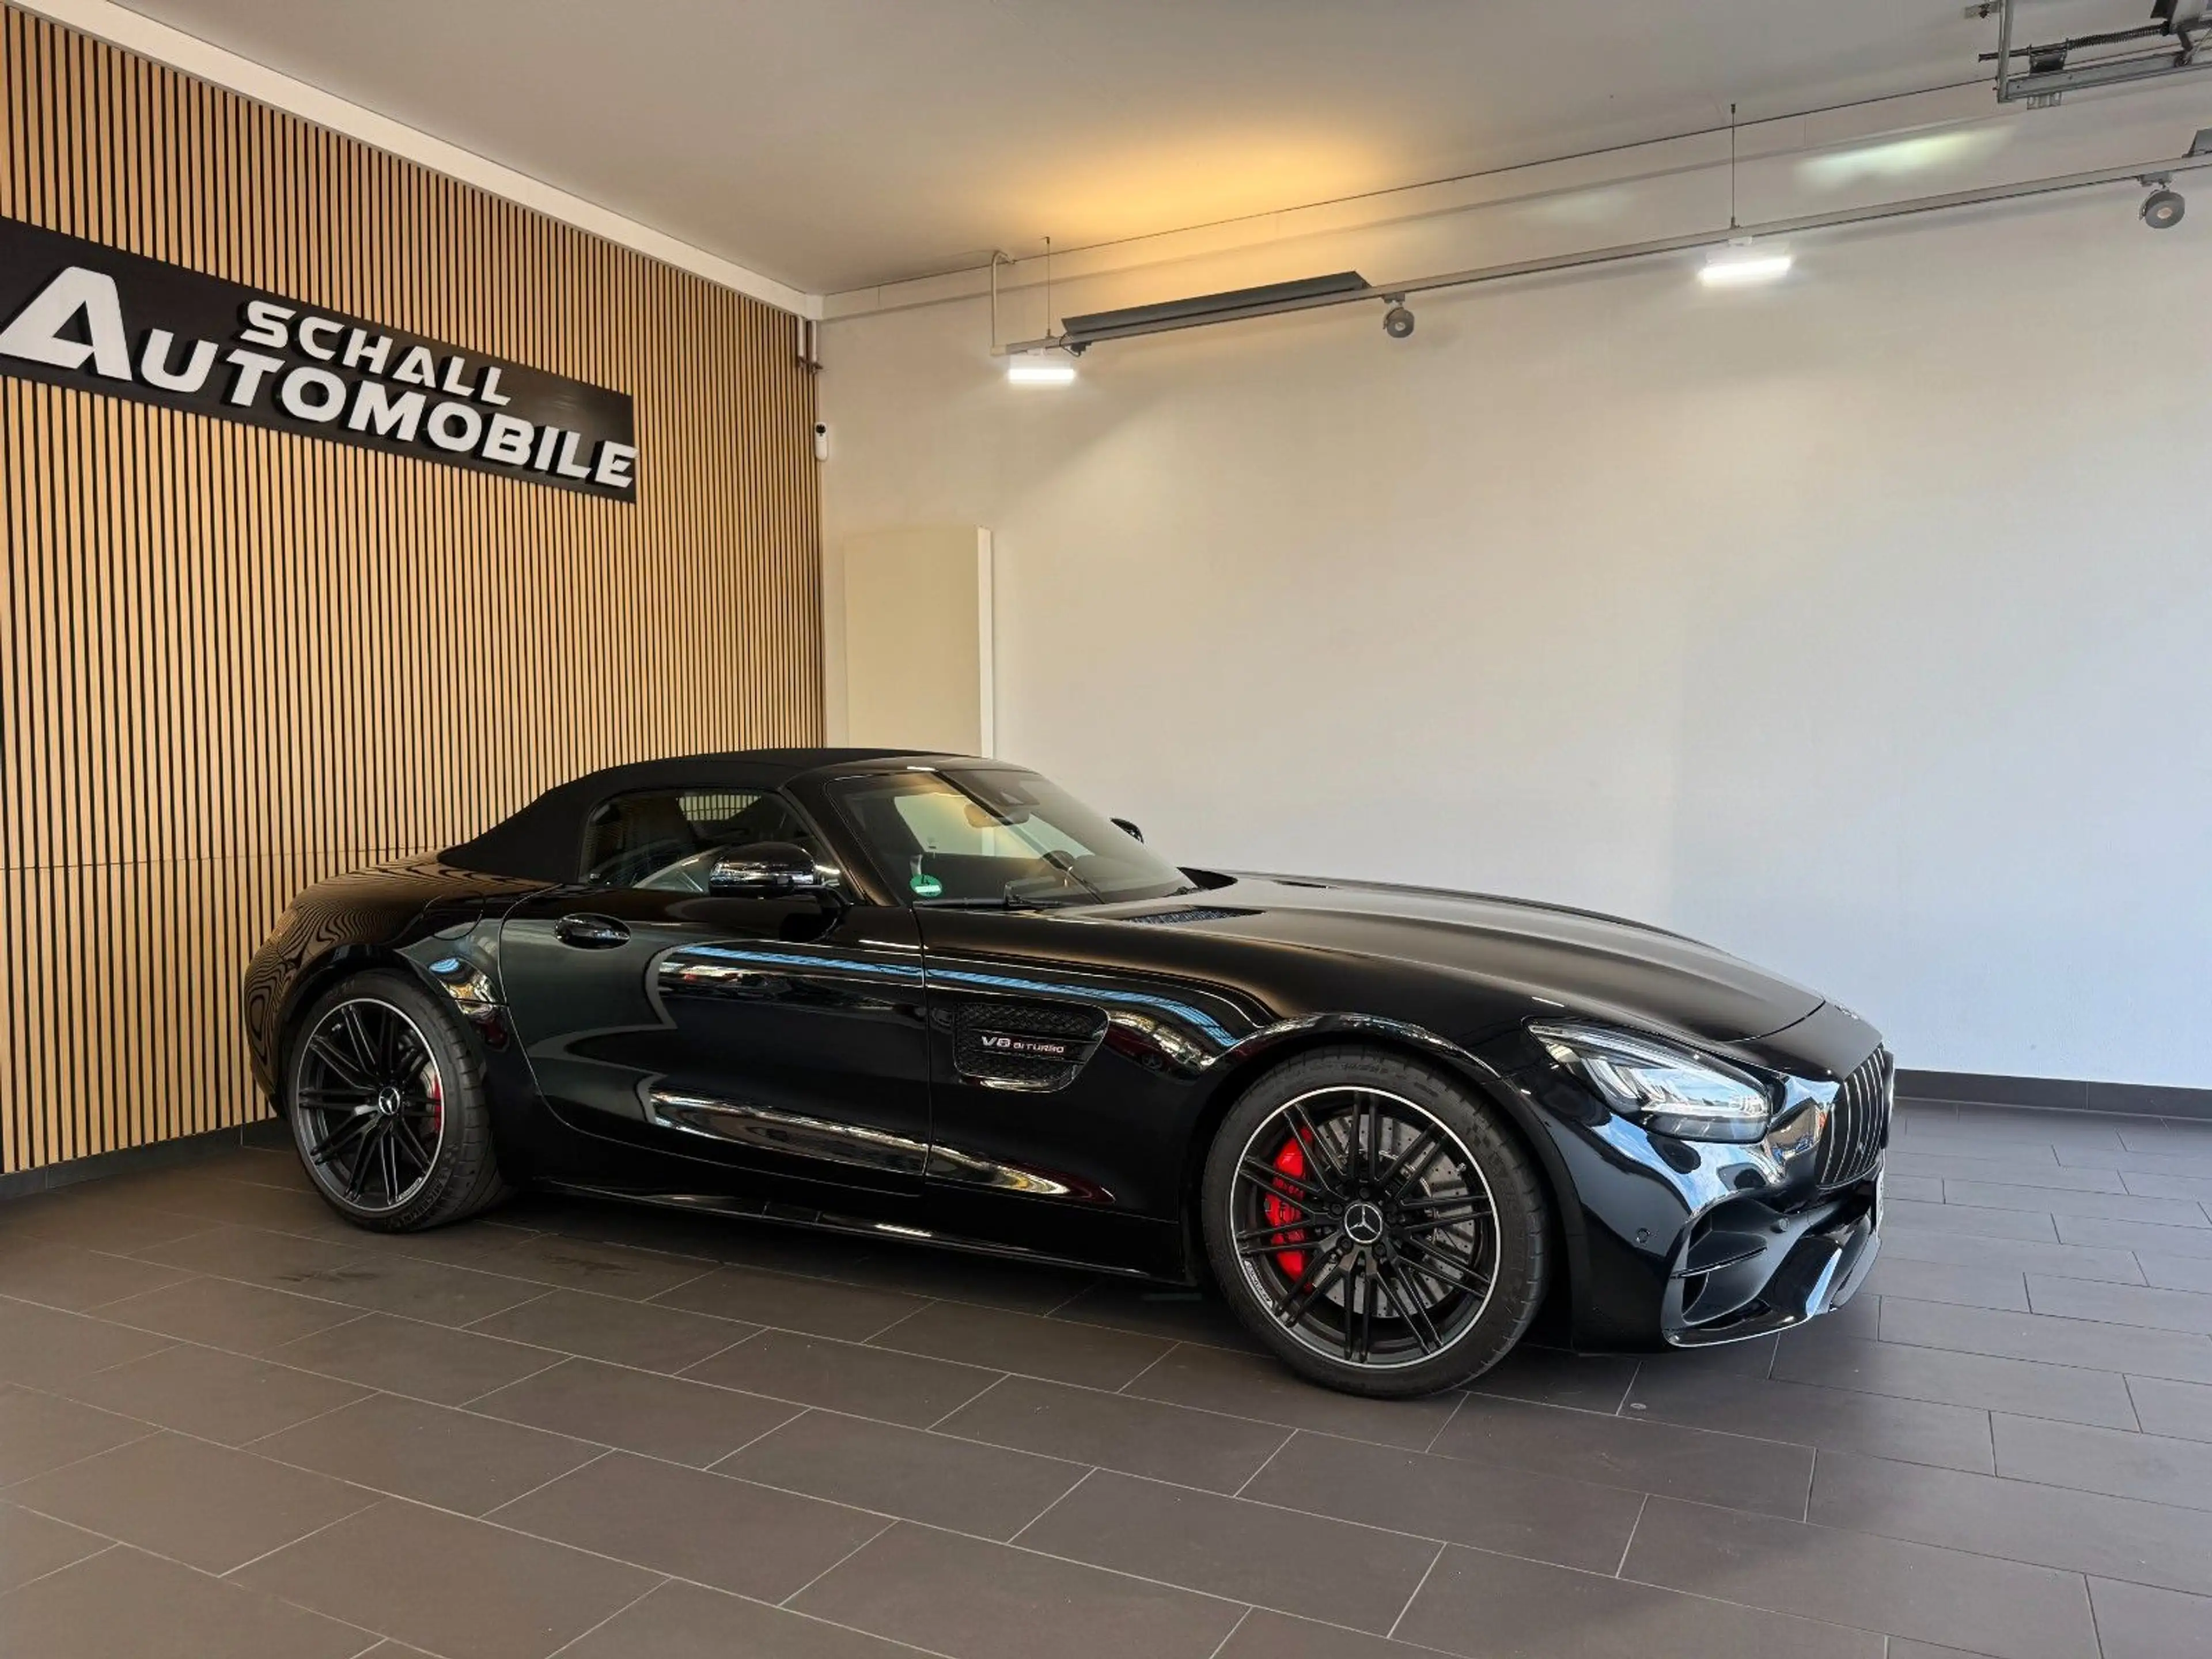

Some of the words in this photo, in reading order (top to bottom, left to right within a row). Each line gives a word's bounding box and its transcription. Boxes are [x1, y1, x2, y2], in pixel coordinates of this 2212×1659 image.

[0, 266, 638, 488] AUTOMOBILE
[240, 300, 511, 406] SCHALL
[982, 1036, 1011, 1048] V8
